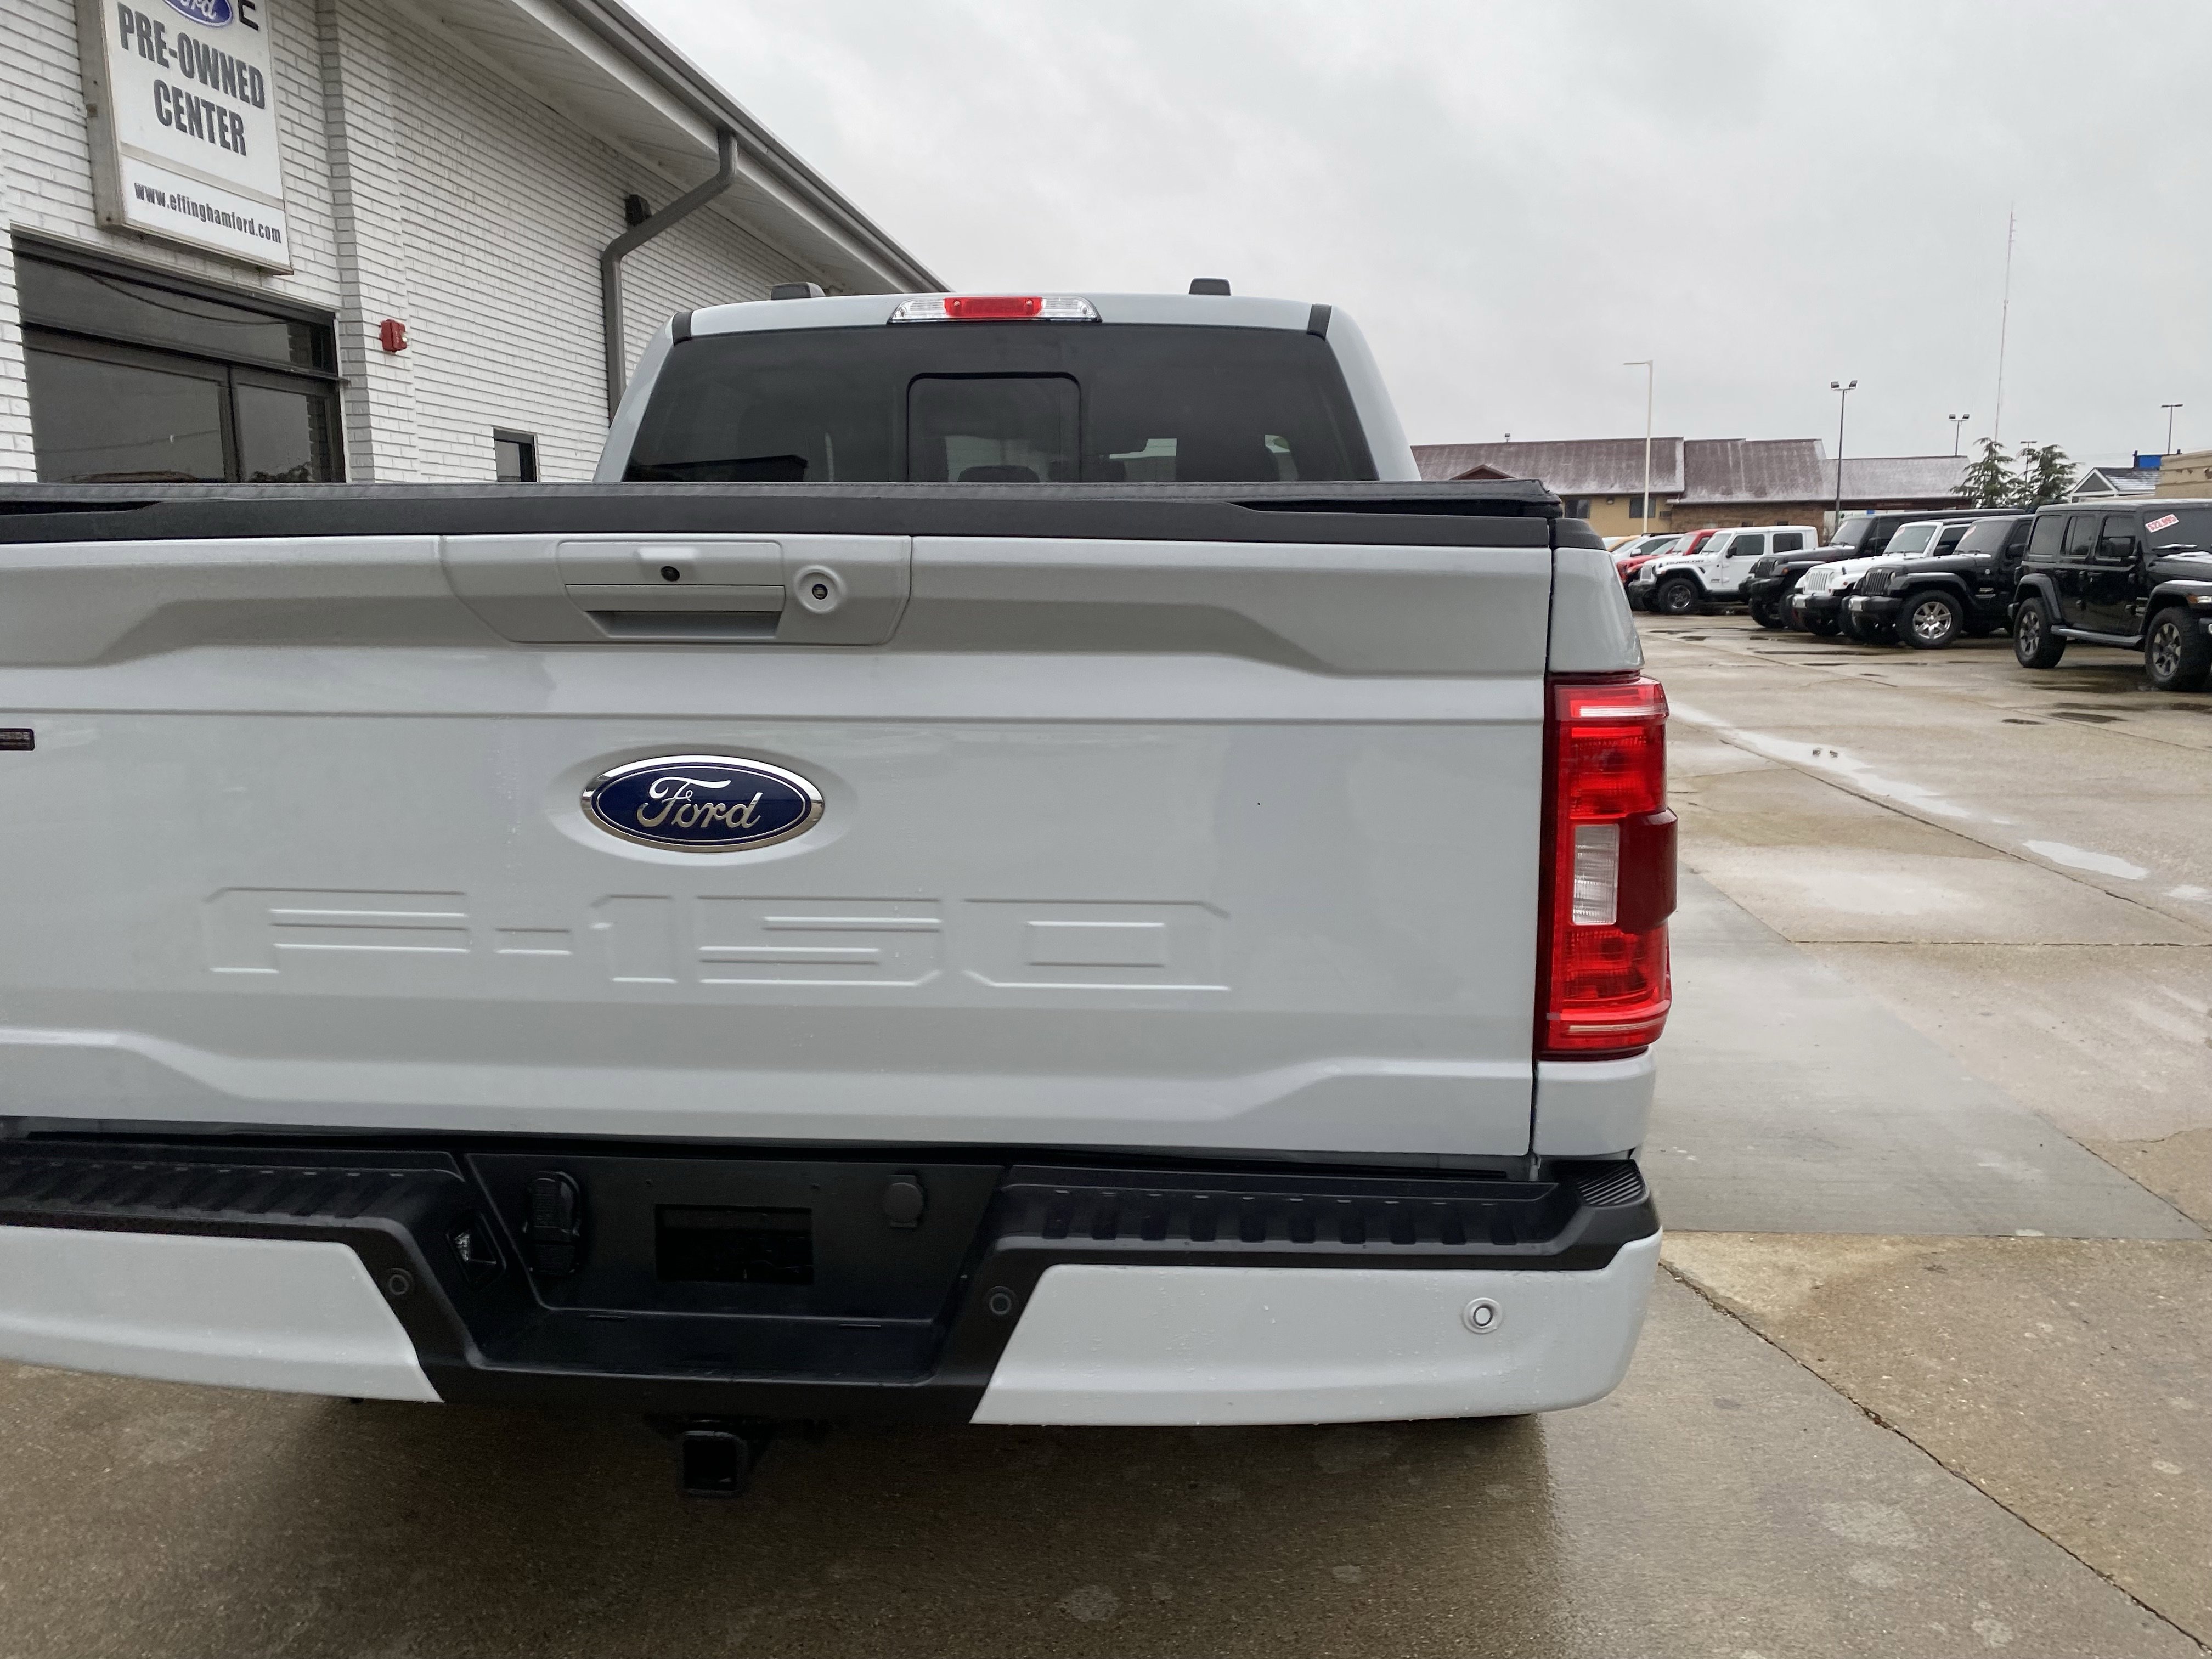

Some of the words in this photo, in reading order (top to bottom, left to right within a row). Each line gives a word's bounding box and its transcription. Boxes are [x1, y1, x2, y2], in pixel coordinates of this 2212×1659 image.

[117, 1, 266, 110] PRE-OWNED
[153, 79, 247, 157] CENTER
[134, 182, 281, 244] www.effinghamford.com
[636, 776, 764, 828] Ford
[202, 886, 1231, 990] F-150
